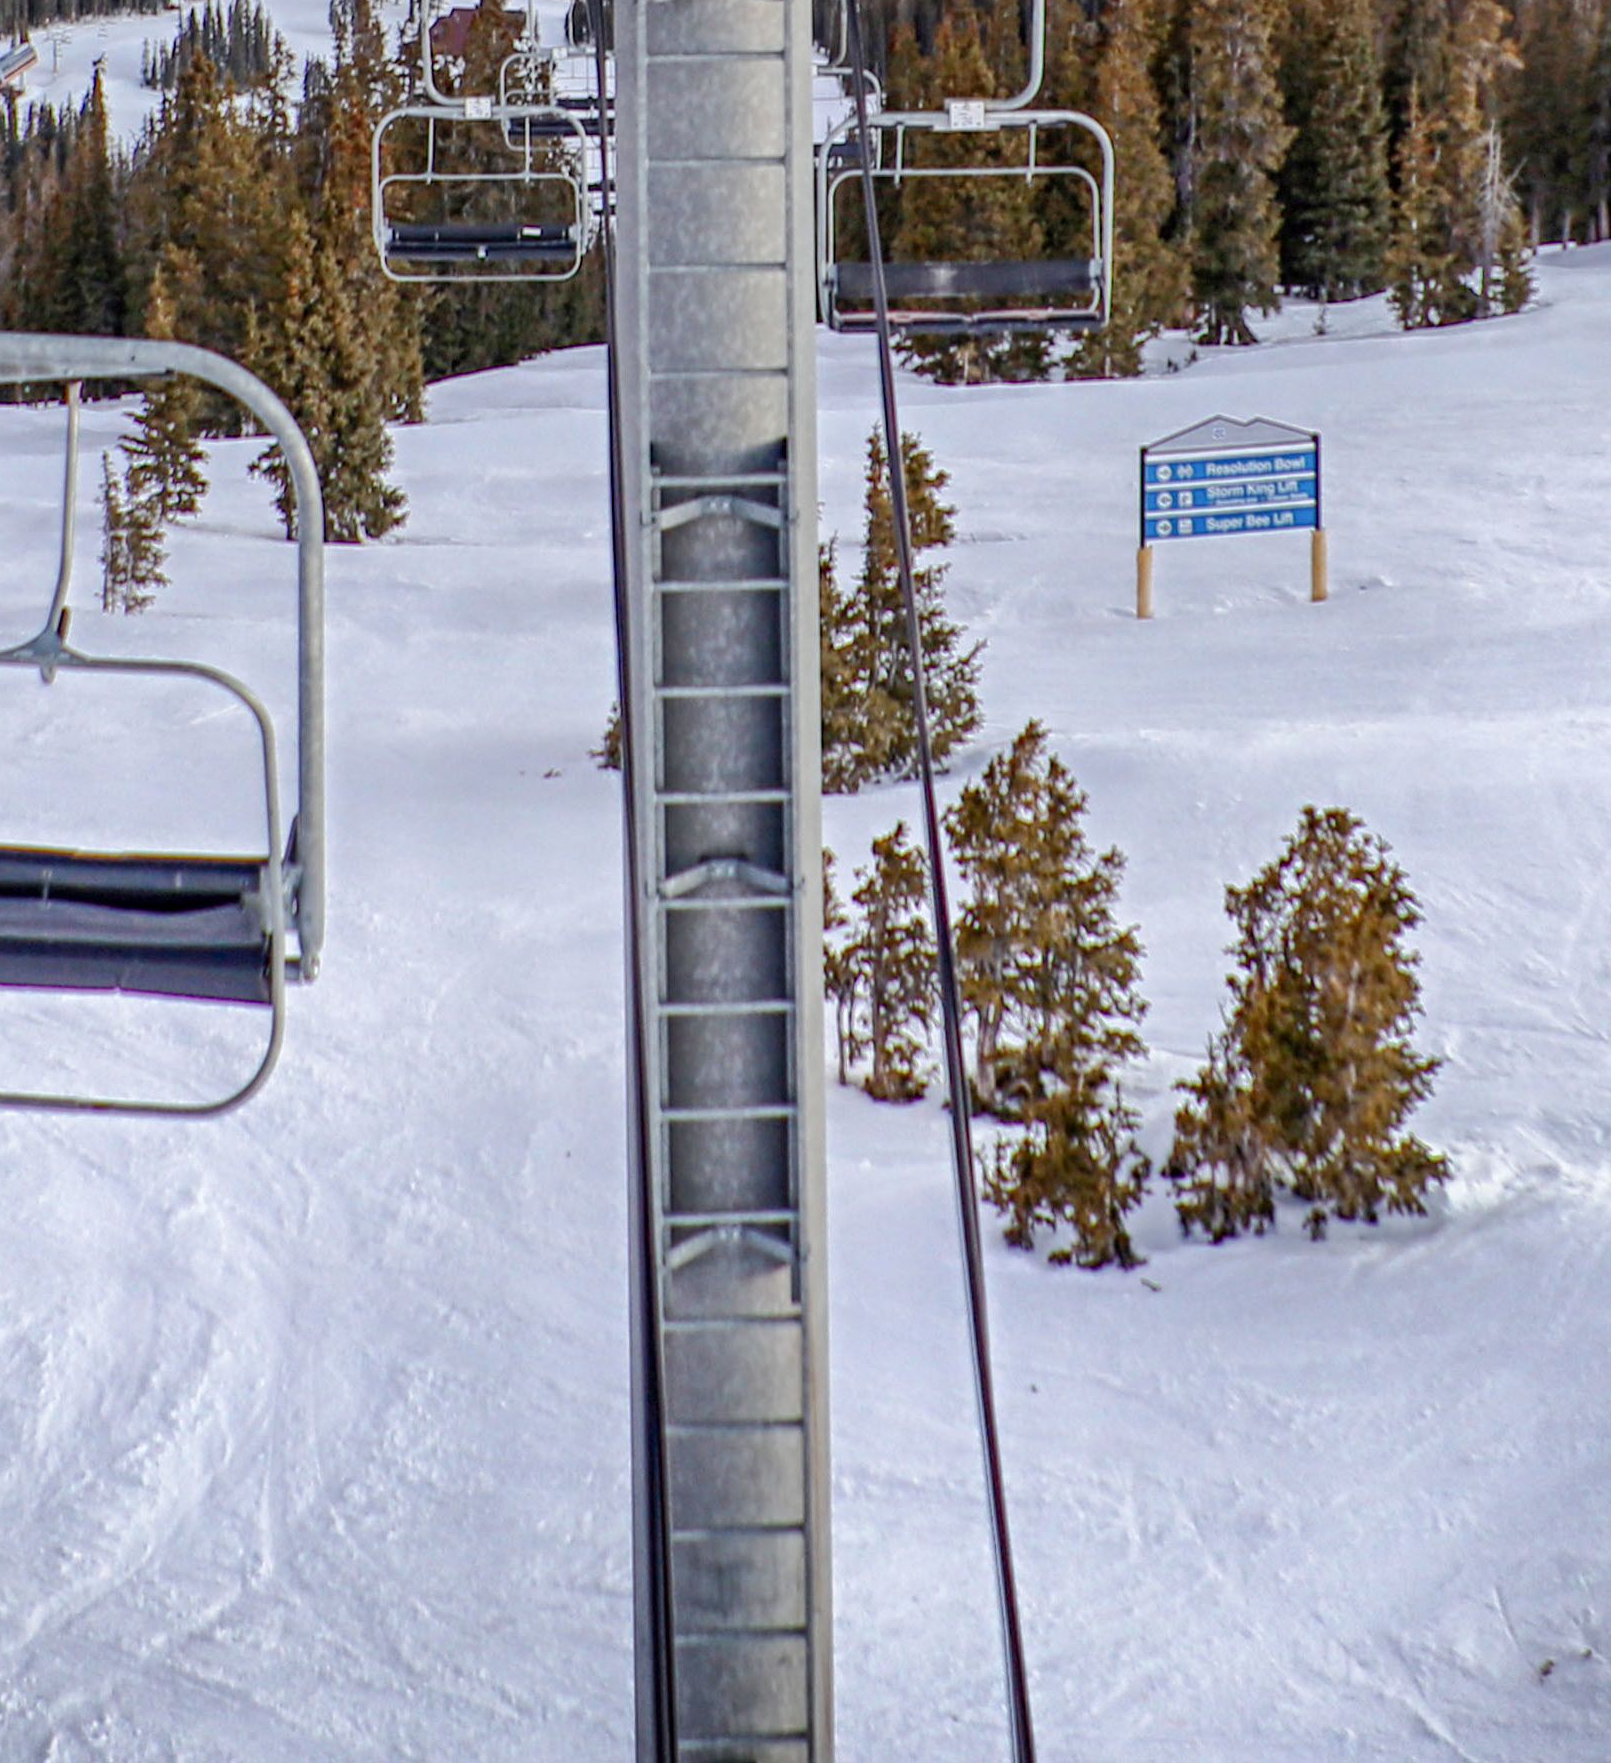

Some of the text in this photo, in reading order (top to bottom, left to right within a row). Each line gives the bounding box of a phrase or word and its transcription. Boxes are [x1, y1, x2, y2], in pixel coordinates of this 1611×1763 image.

[1206, 455, 1305, 476] Resolution Bowl
[1207, 485, 1244, 500] Storm
[1246, 482, 1276, 497] King
[1277, 479, 1298, 493] Lift
[1206, 510, 1294, 532] Super Bee Lift
